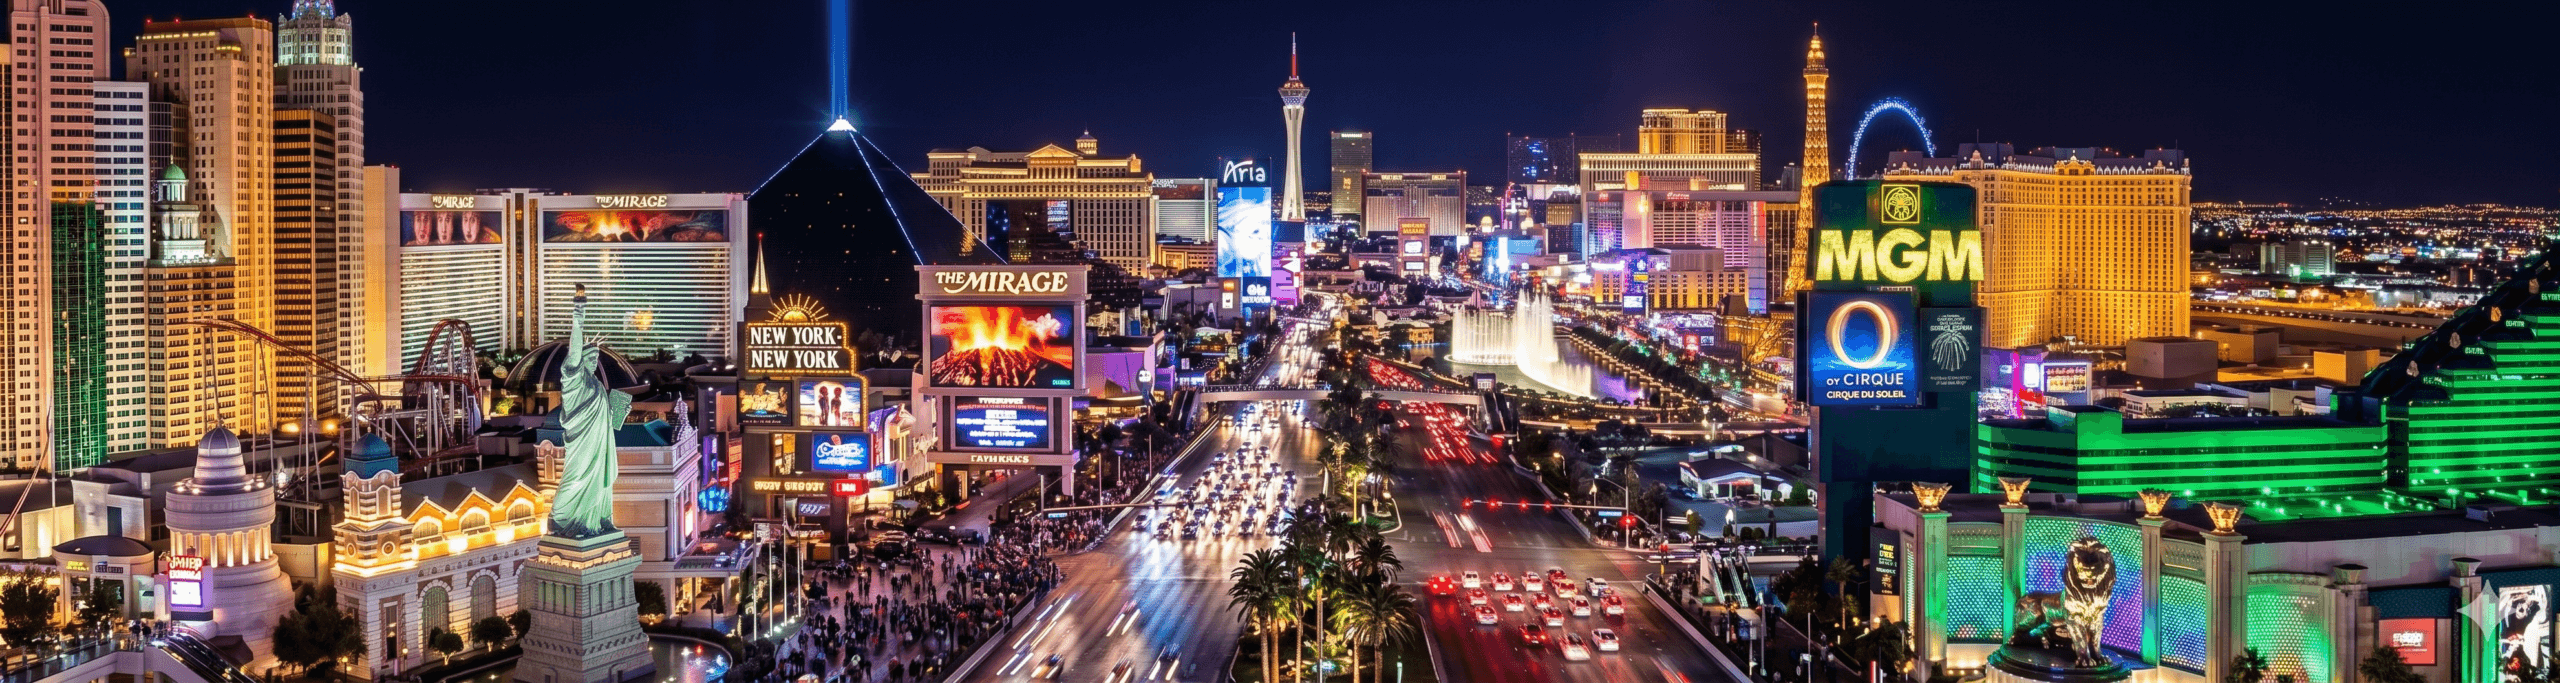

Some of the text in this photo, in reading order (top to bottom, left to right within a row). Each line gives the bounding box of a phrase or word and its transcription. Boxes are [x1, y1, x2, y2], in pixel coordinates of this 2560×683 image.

[1223, 160, 1266, 184] Aria
[601, 195, 668, 208] MIRAGE
[1815, 228, 1985, 283] MGM
[935, 271, 1069, 295] THE MIRAGE
[750, 326, 787, 345] NEW
[751, 350, 840, 368] NEW YORK
[1843, 372, 1904, 387] CIRQUE
[1826, 390, 1906, 401] CIRQUE DU SOLEIL
